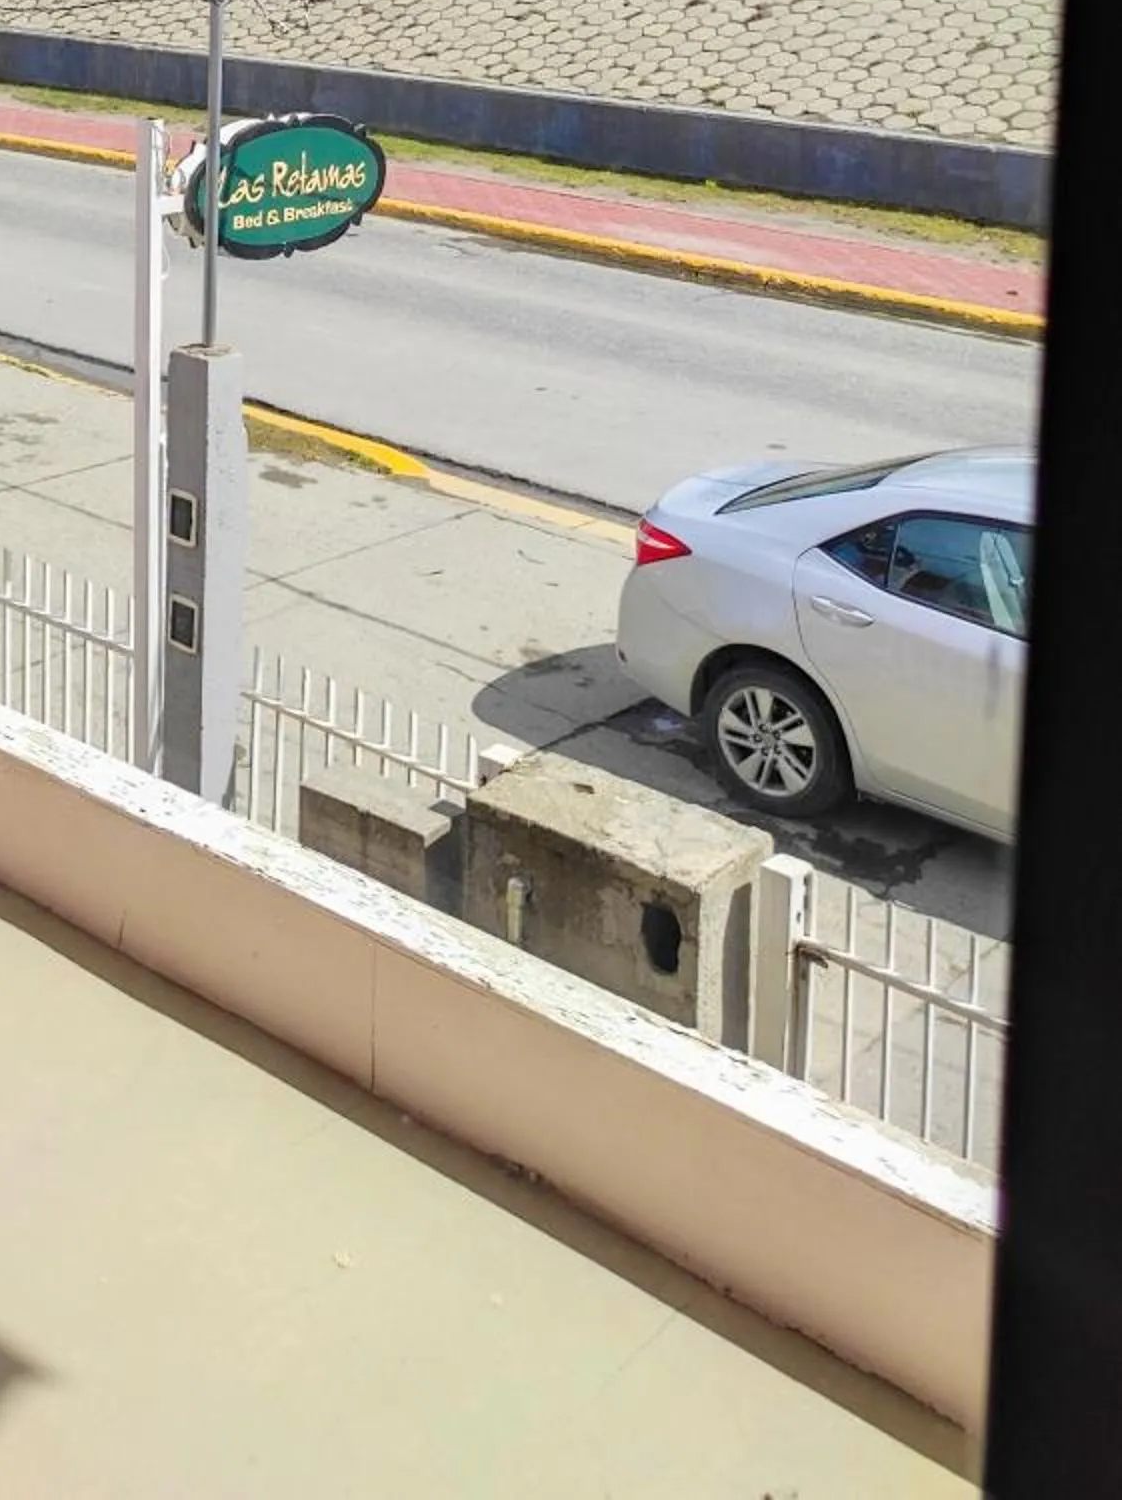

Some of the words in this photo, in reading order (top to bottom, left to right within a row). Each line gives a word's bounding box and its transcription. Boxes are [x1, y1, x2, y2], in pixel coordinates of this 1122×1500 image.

[218, 165, 265, 208] Las
[272, 150, 366, 197] Retamas
[233, 210, 263, 230] Bed
[266, 209, 281, 225] &
[283, 198, 353, 222] Breakfast
